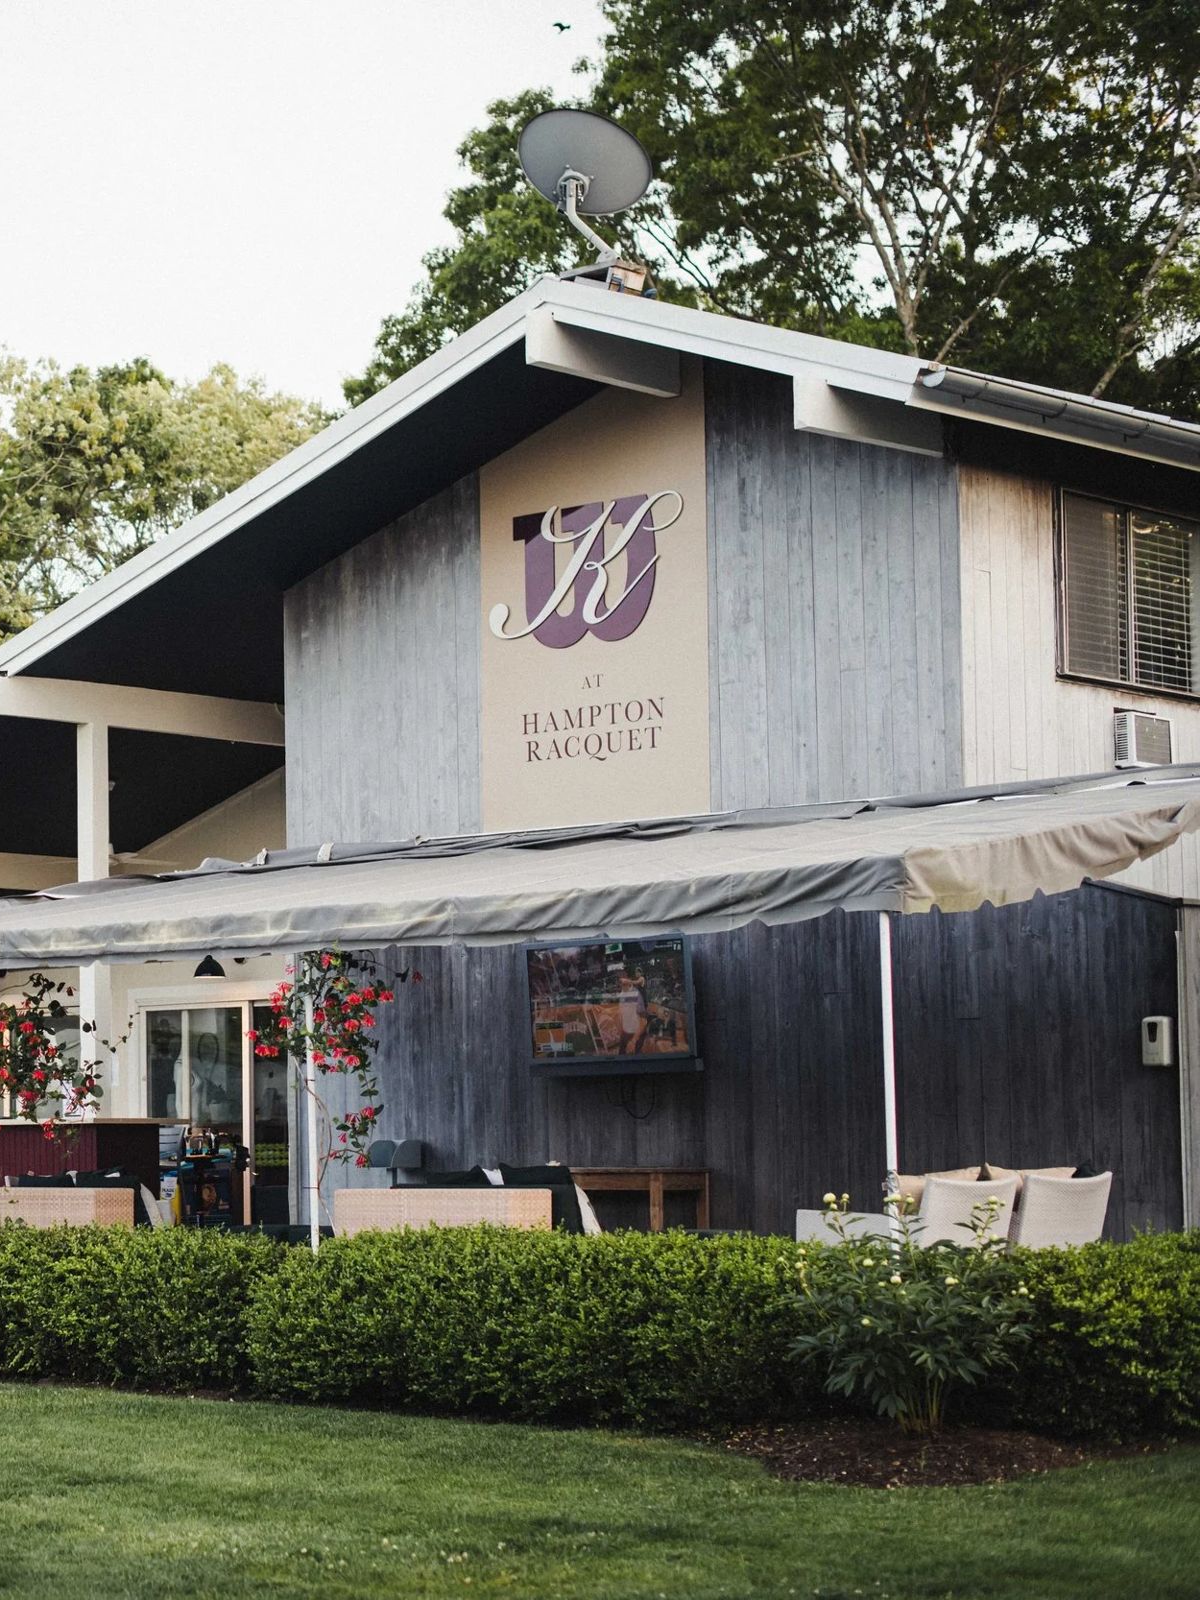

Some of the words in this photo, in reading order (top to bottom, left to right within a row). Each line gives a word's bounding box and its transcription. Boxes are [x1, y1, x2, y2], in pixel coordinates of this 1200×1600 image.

[581, 673, 605, 690] AT
[521, 697, 665, 735] HAMPTON
[526, 726, 662, 762] RACQUET
